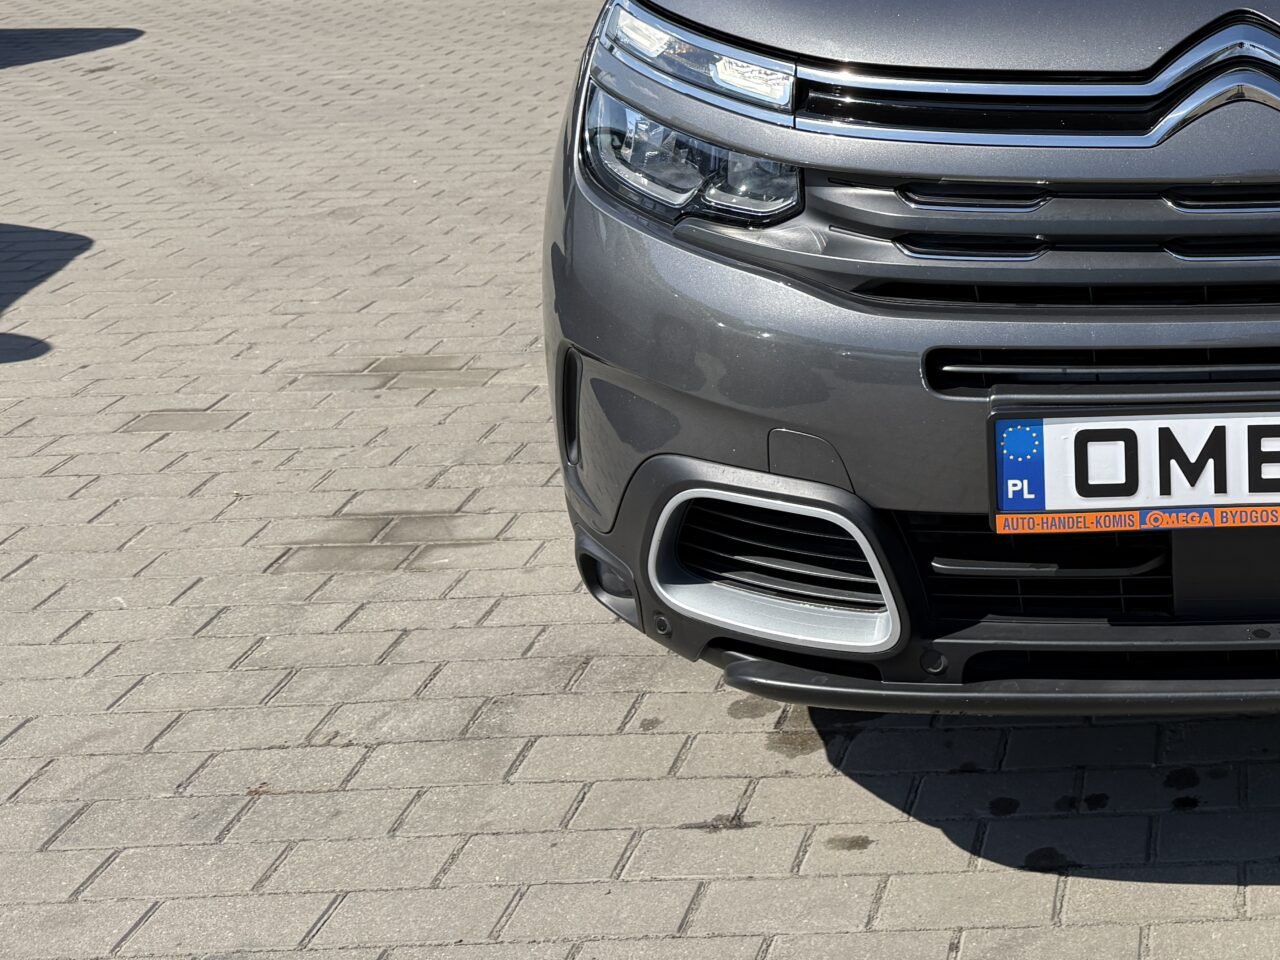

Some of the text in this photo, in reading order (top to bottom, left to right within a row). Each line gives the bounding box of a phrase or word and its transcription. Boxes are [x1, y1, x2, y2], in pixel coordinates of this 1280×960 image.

[1007, 480, 1035, 499] PL
[1003, 514, 1135, 531] AUTO-HANDEL-KOMIS
[1145, 510, 1213, 528] OMEGA
